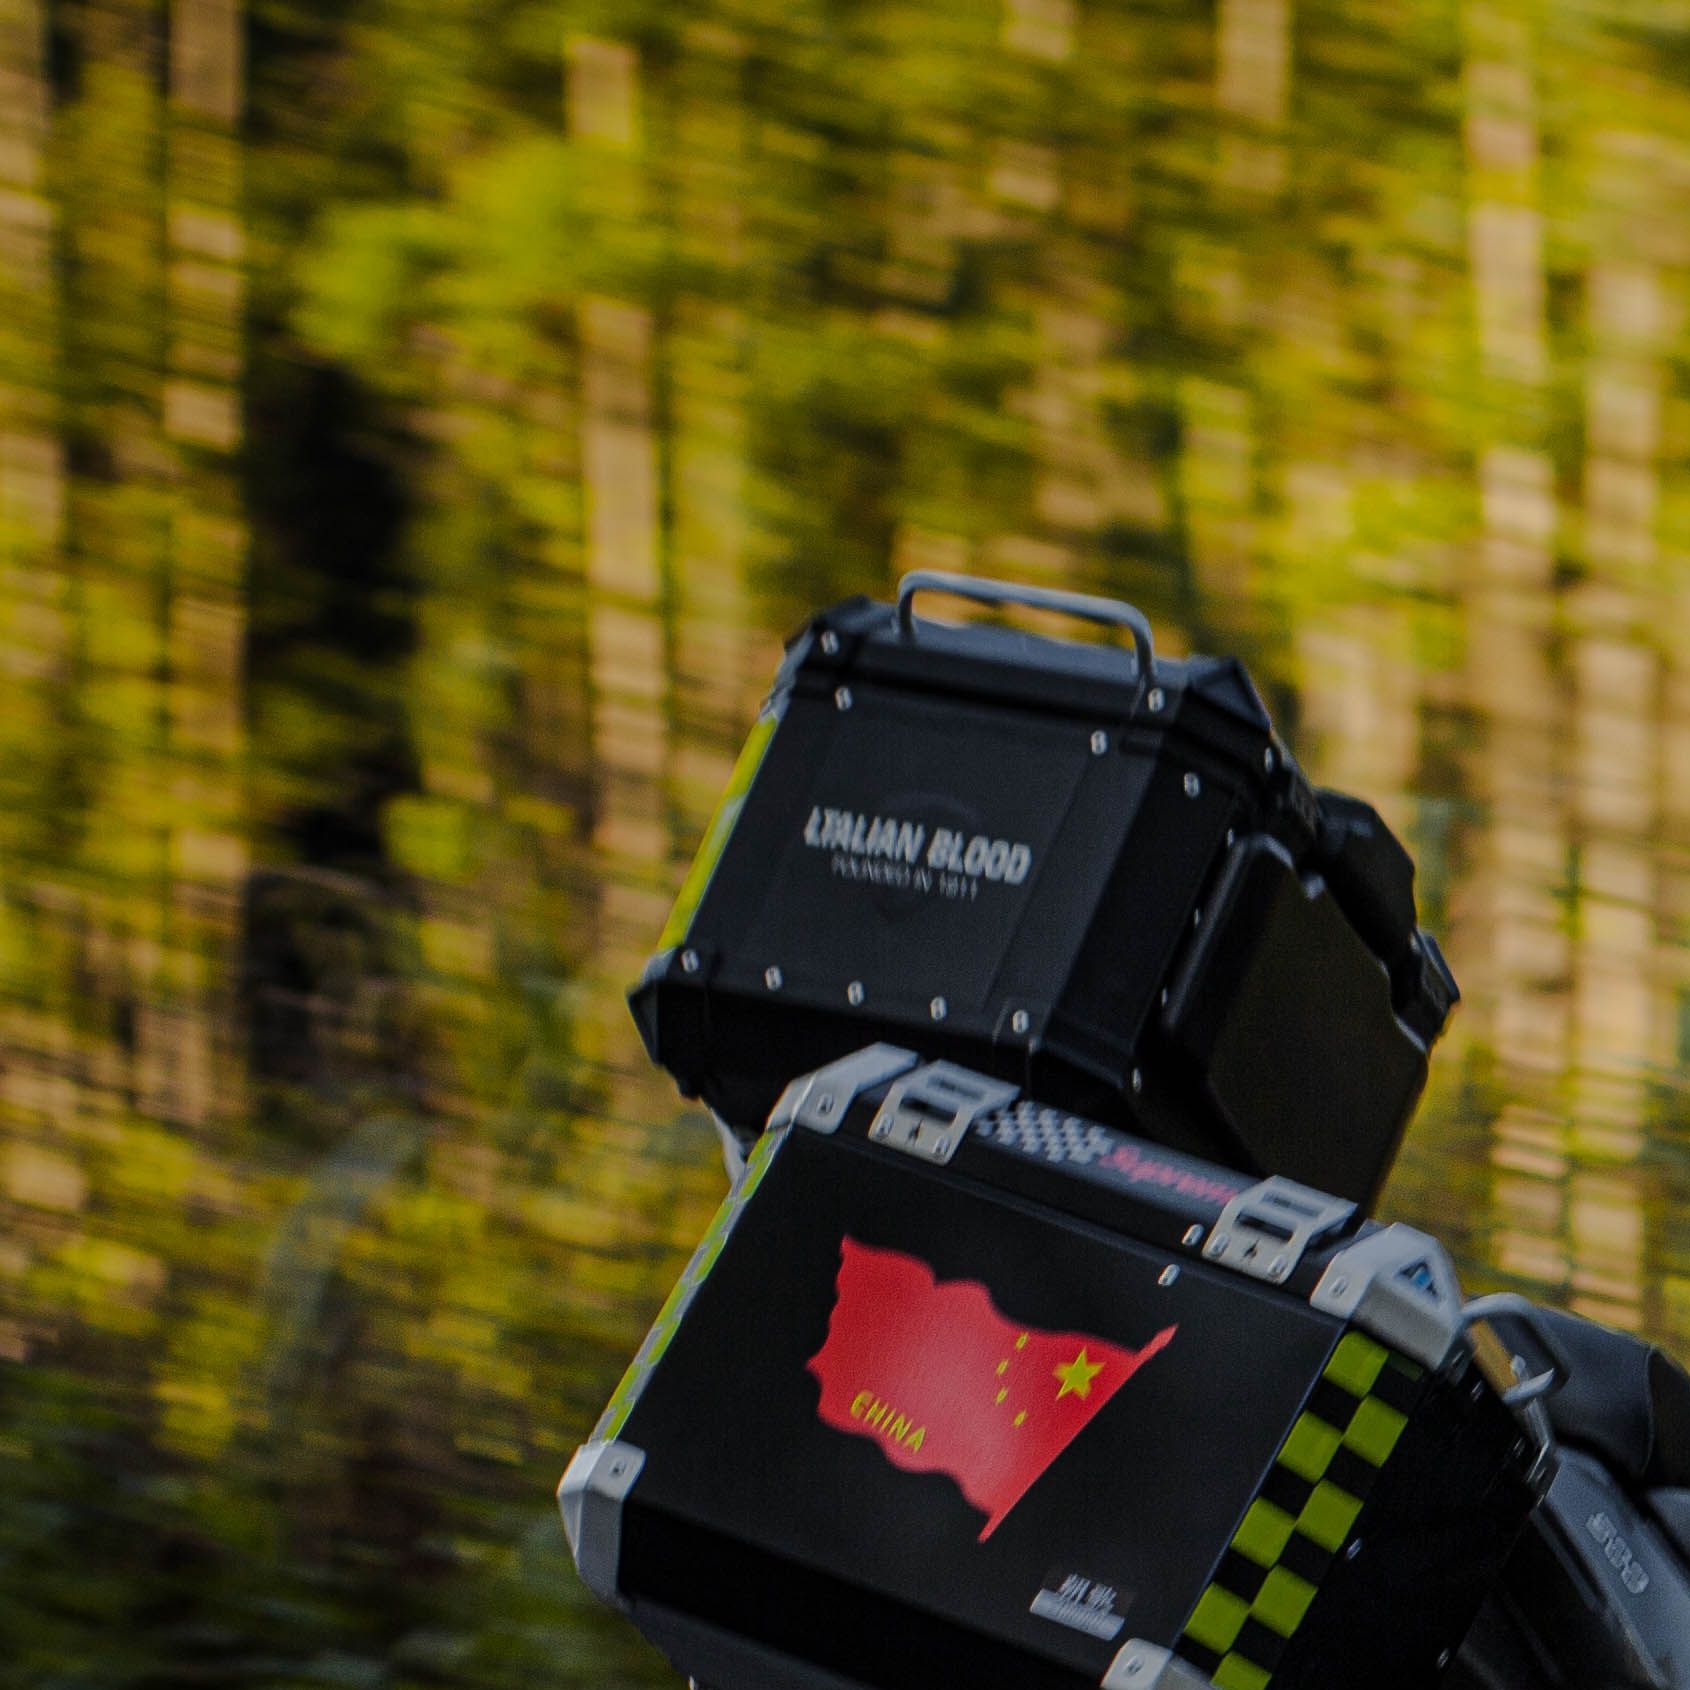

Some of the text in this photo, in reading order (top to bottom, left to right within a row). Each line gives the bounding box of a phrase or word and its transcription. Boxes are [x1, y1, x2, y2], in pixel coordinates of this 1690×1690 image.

[803, 805, 1032, 886] ITALIAN BLOOD
[850, 1389, 926, 1456] CHINA
